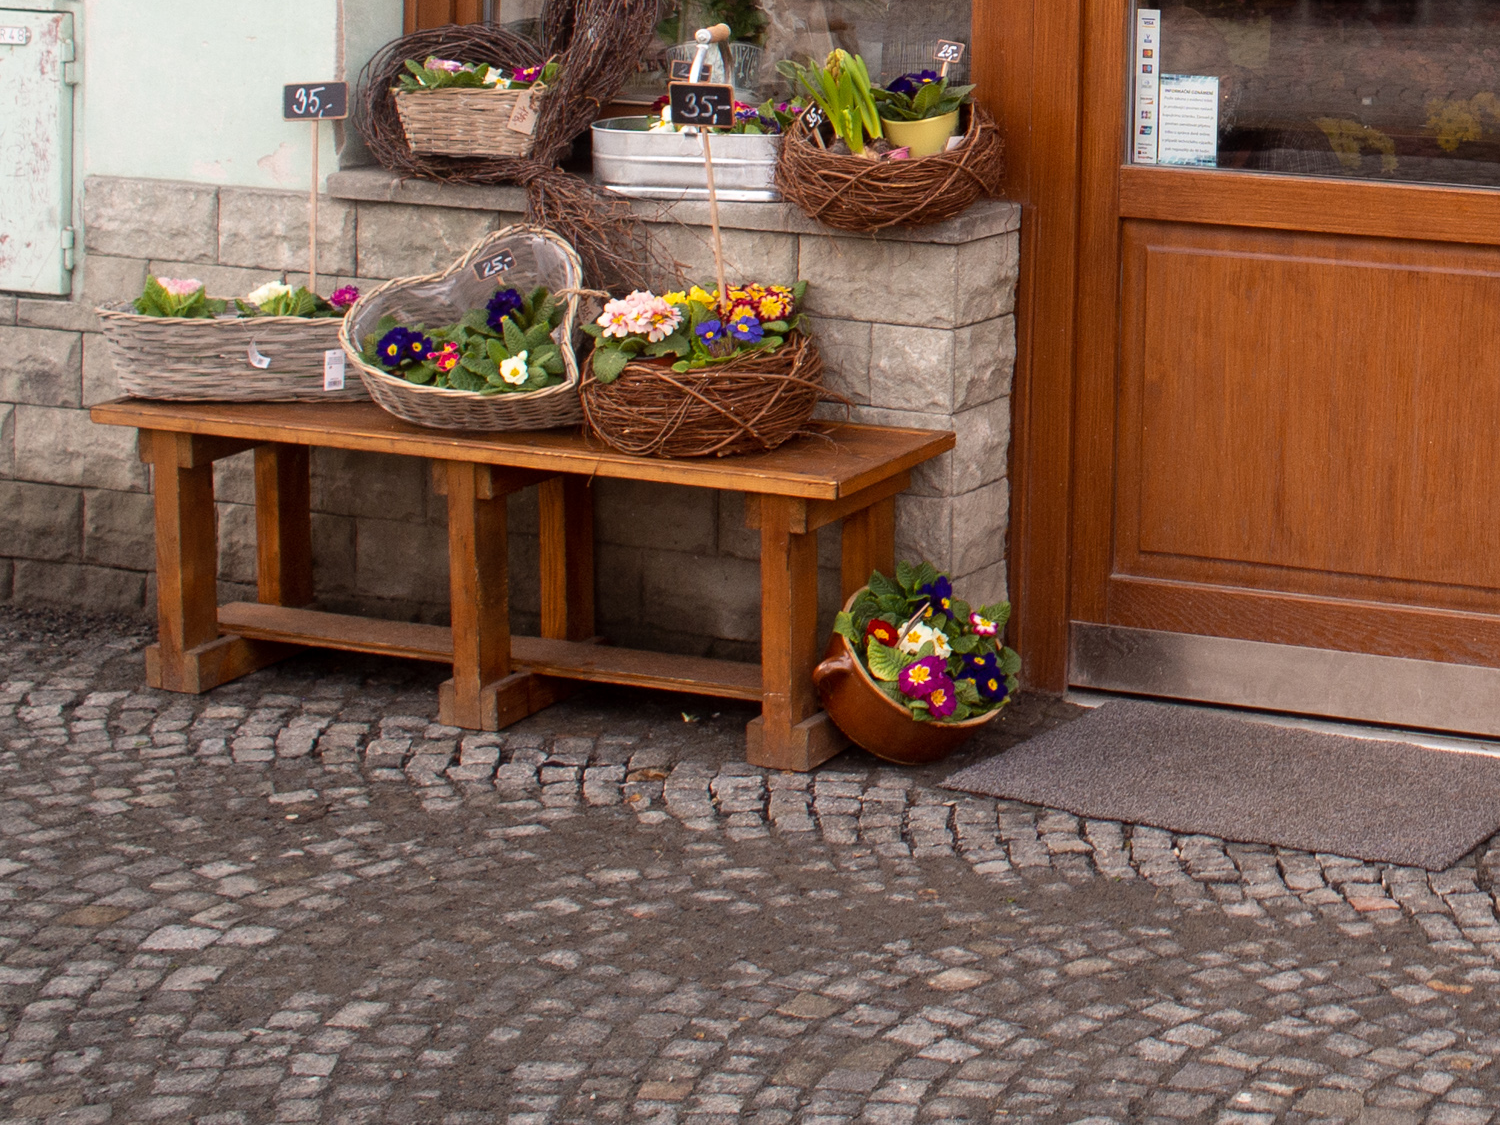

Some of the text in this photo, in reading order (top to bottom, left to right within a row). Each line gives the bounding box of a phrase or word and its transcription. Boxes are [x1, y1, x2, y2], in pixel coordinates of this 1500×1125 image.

[937, 44, 959, 61] 25,-
[292, 86, 332, 118] 35,-
[680, 93, 731, 125] 35,-
[482, 255, 512, 277] 25,-
